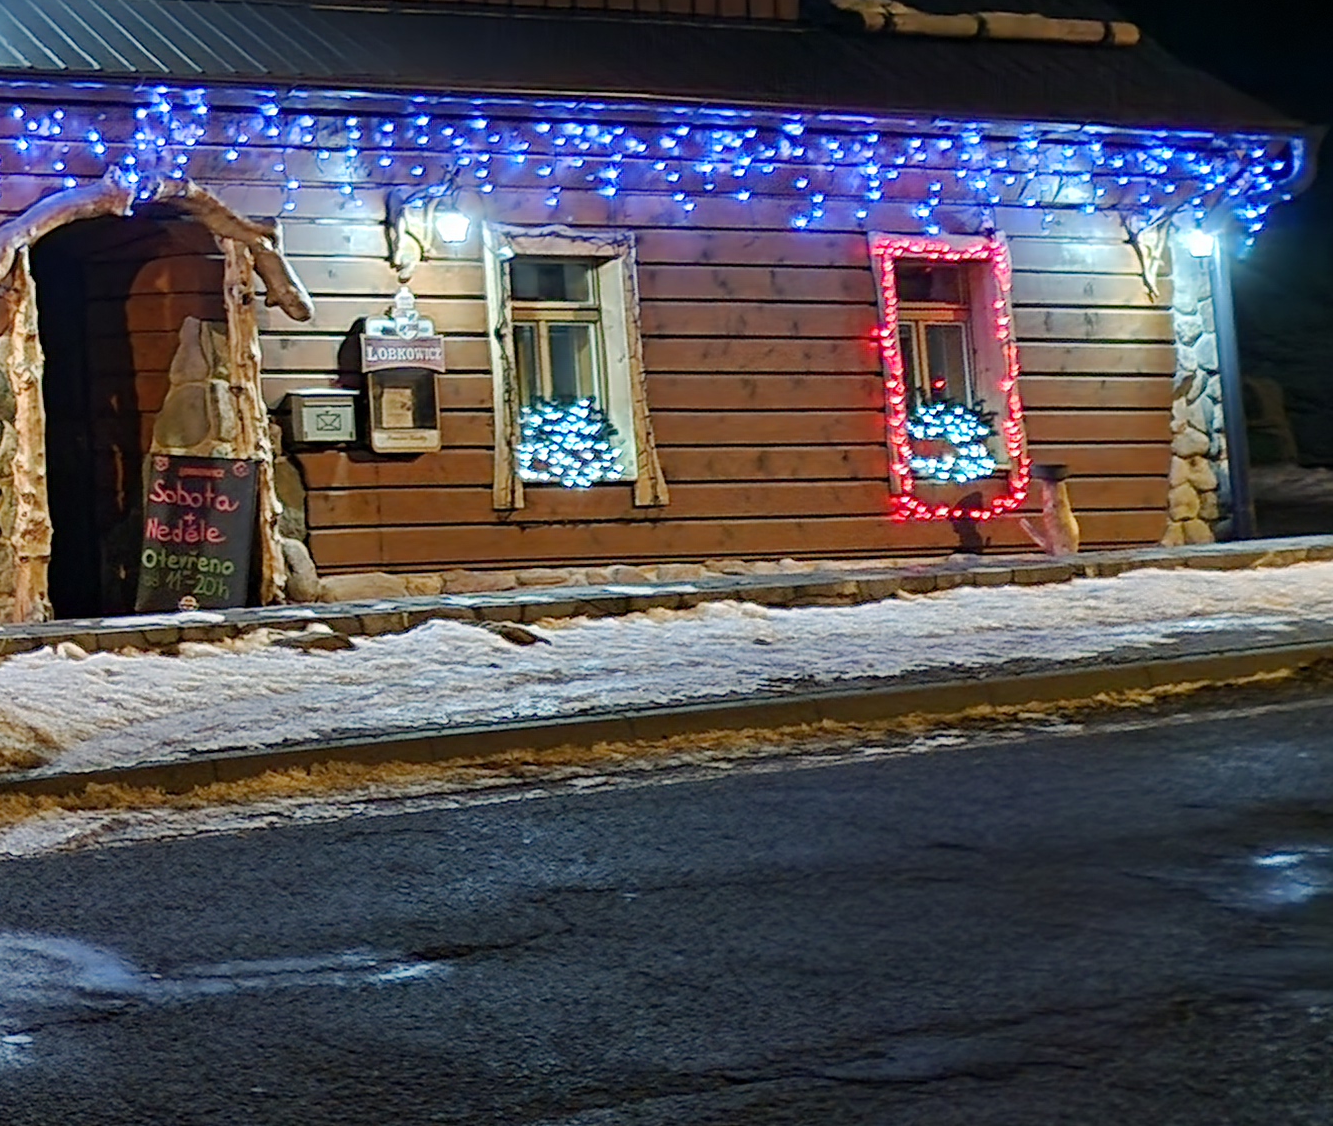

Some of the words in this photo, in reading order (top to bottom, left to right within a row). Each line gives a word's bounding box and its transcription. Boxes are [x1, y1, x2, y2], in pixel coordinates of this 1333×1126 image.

[366, 345, 442, 362] LOBKOWICZ
[149, 478, 240, 512] Sobota
[145, 517, 228, 544] Neděle
[141, 548, 234, 575] Otevřeno
